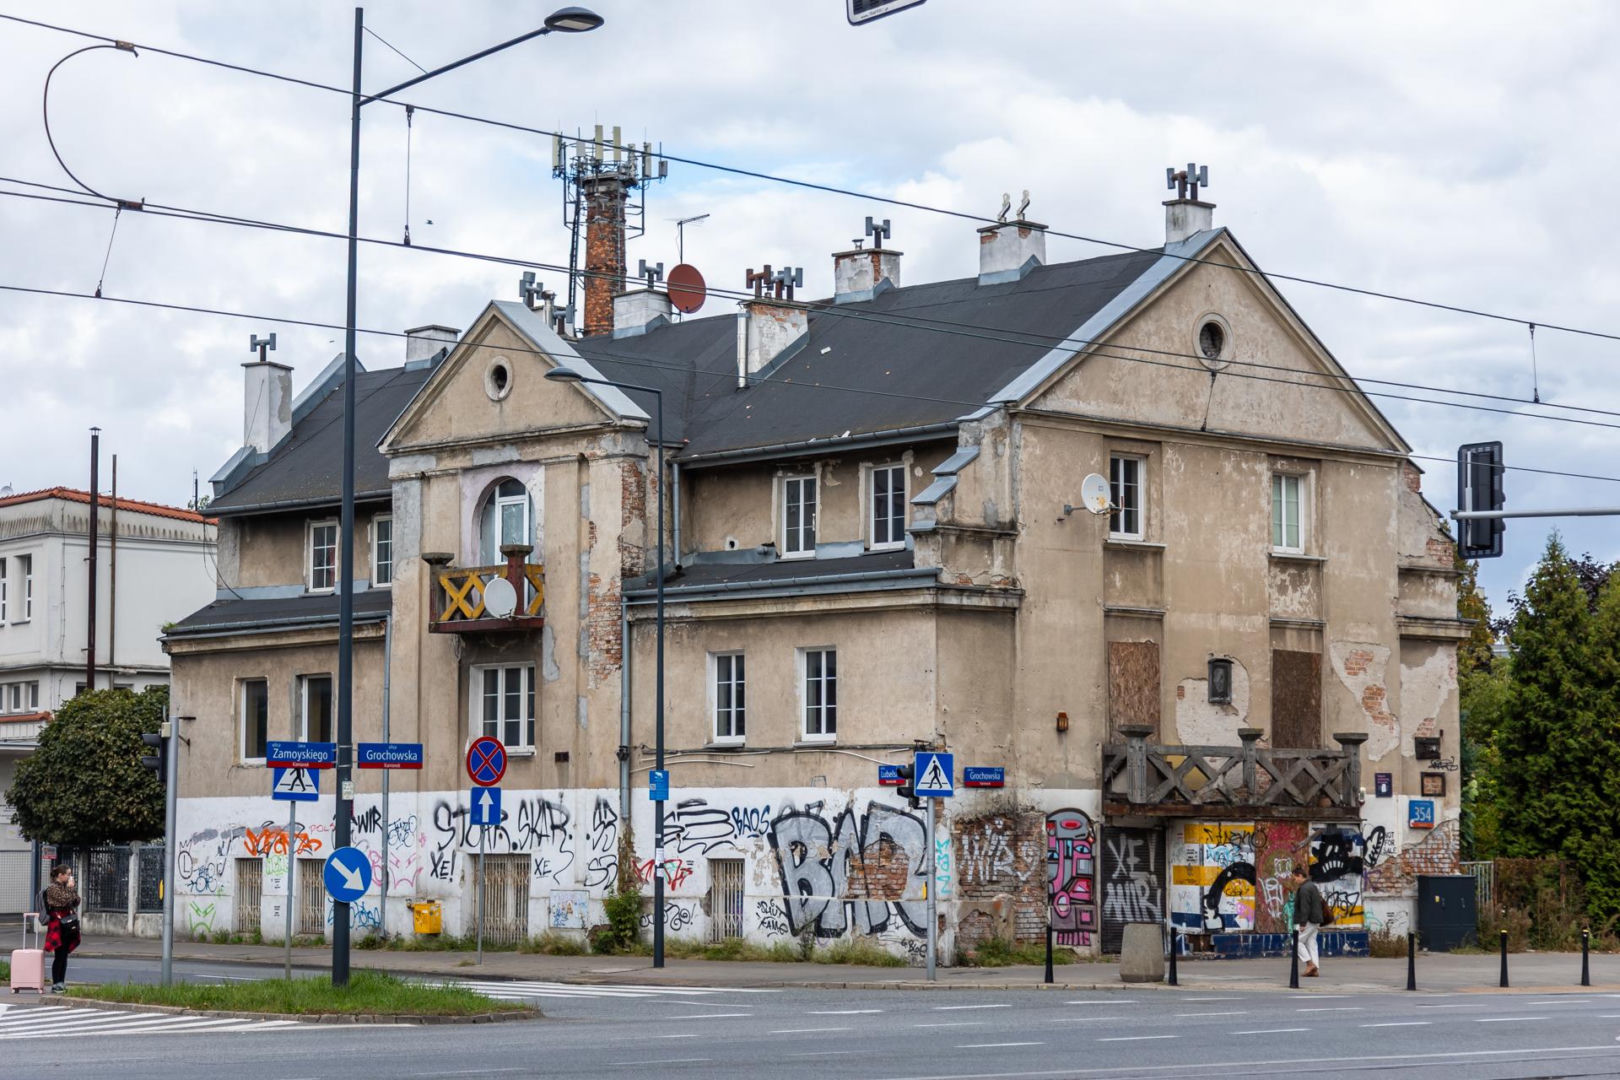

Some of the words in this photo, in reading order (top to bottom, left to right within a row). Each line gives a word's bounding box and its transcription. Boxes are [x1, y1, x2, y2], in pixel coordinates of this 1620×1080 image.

[272, 748, 329, 763] Zamoyskiego
[366, 749, 418, 761] Grochowska
[969, 771, 1001, 781] Grochowska
[1414, 806, 1432, 822] 354
